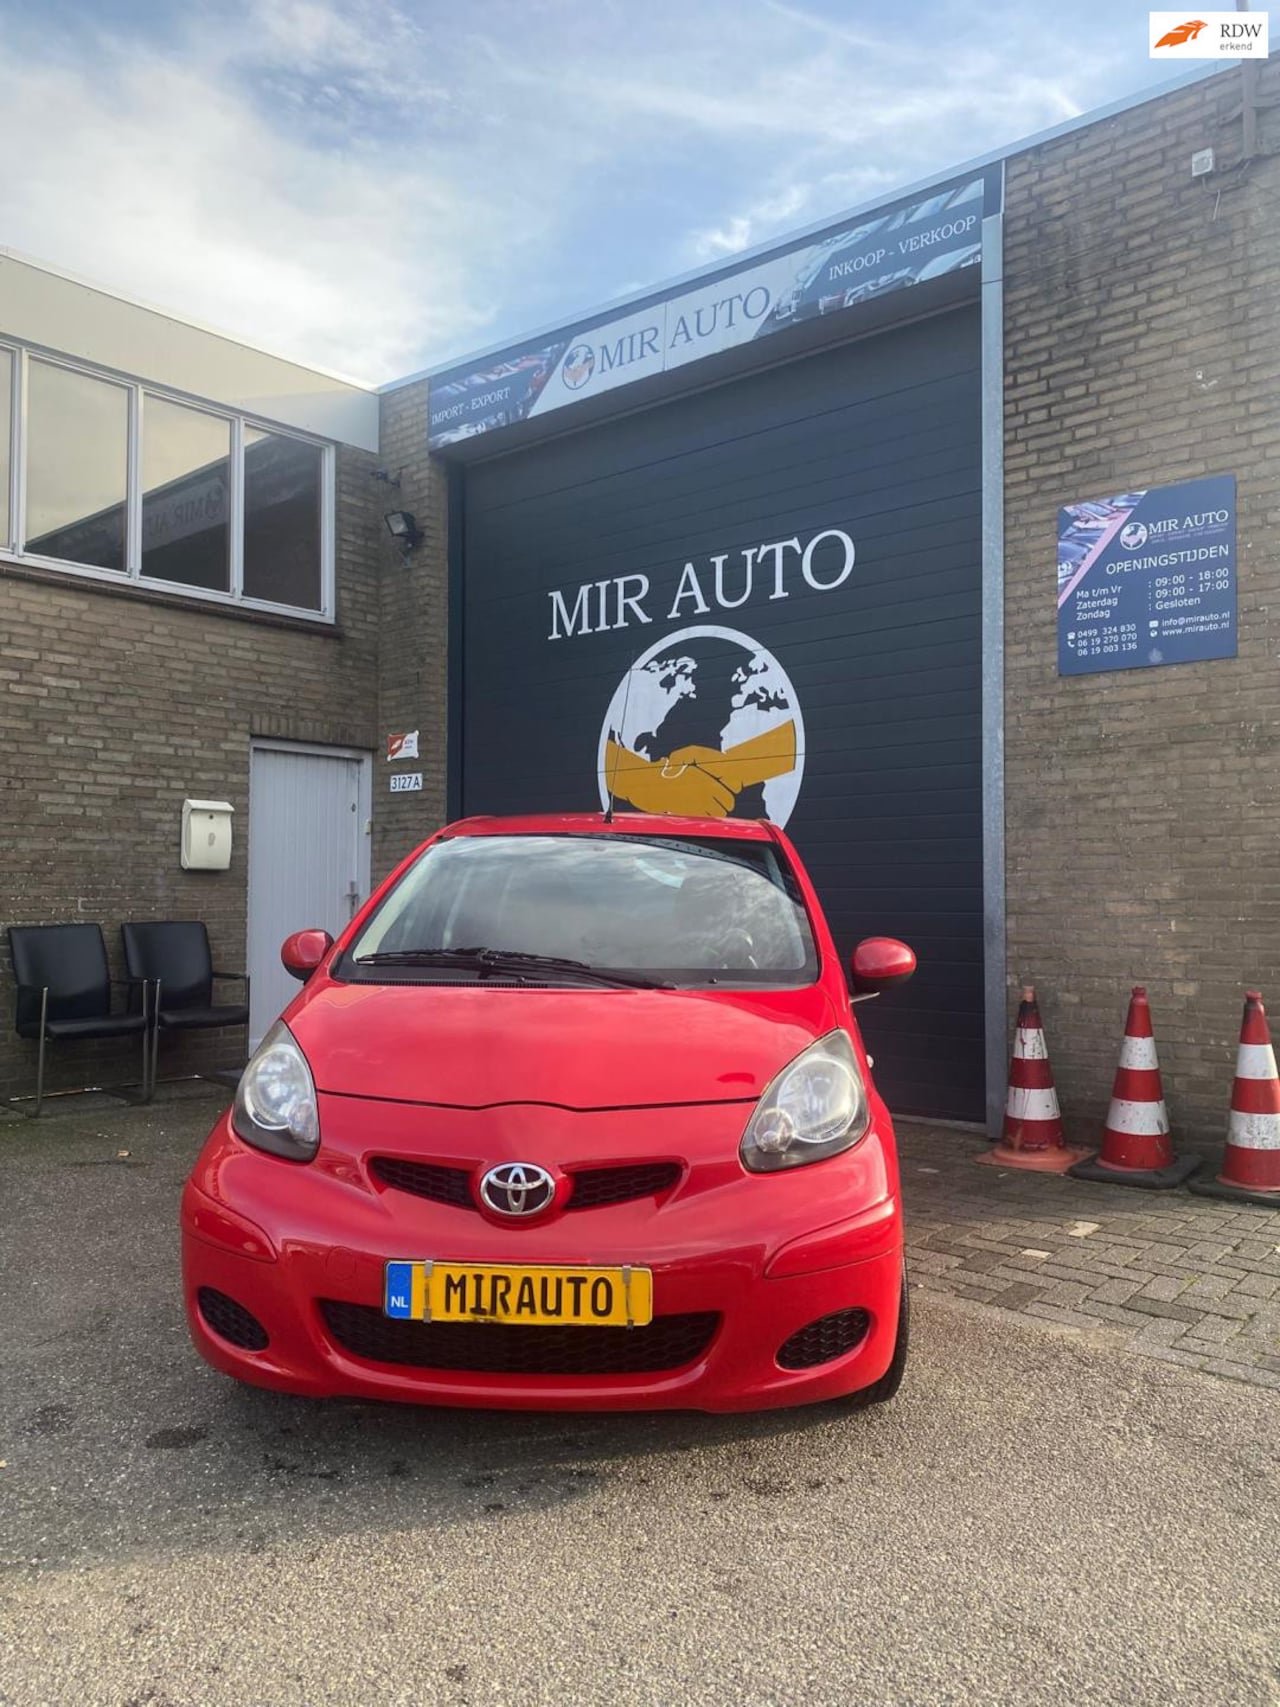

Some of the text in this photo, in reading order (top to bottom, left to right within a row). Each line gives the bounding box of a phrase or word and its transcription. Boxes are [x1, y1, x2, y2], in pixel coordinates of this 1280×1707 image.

[829, 249, 885, 281] INKOOP
[898, 215, 977, 254] VERKOOP
[598, 286, 770, 374] MIR AUTO
[432, 402, 464, 425] IMPORT
[471, 386, 511, 410] EXPORT
[1149, 518, 1179, 535] MIR
[1182, 510, 1229, 529] AUTO
[1106, 544, 1229, 575] OPENINGSTIJDEN
[548, 529, 856, 640] MIR AUTO
[1076, 590, 1090, 600] Ma
[1092, 587, 1109, 598] t/m
[1111, 585, 1122, 594] Vr
[1155, 574, 1185, 587] 09:00
[1199, 567, 1229, 581] 18:00
[1076, 597, 1119, 610] Zaterdag
[1155, 586, 1185, 599] 09:00
[1199, 579, 1229, 593] 17:00
[1076, 609, 1111, 621] Zondag
[1155, 597, 1201, 610] Gesloten
[1162, 610, 1230, 627] info@mirauto.nl
[1077, 623, 1137, 638] 0499 324 830
[1077, 632, 1138, 648] 06 19 270 070
[1162, 620, 1230, 636] www.mirauto.nl
[1077, 641, 1138, 657] 06 19 003 136
[391, 775, 420, 790] 3127A
[391, 1273, 613, 1318] NL MIRAUTO
